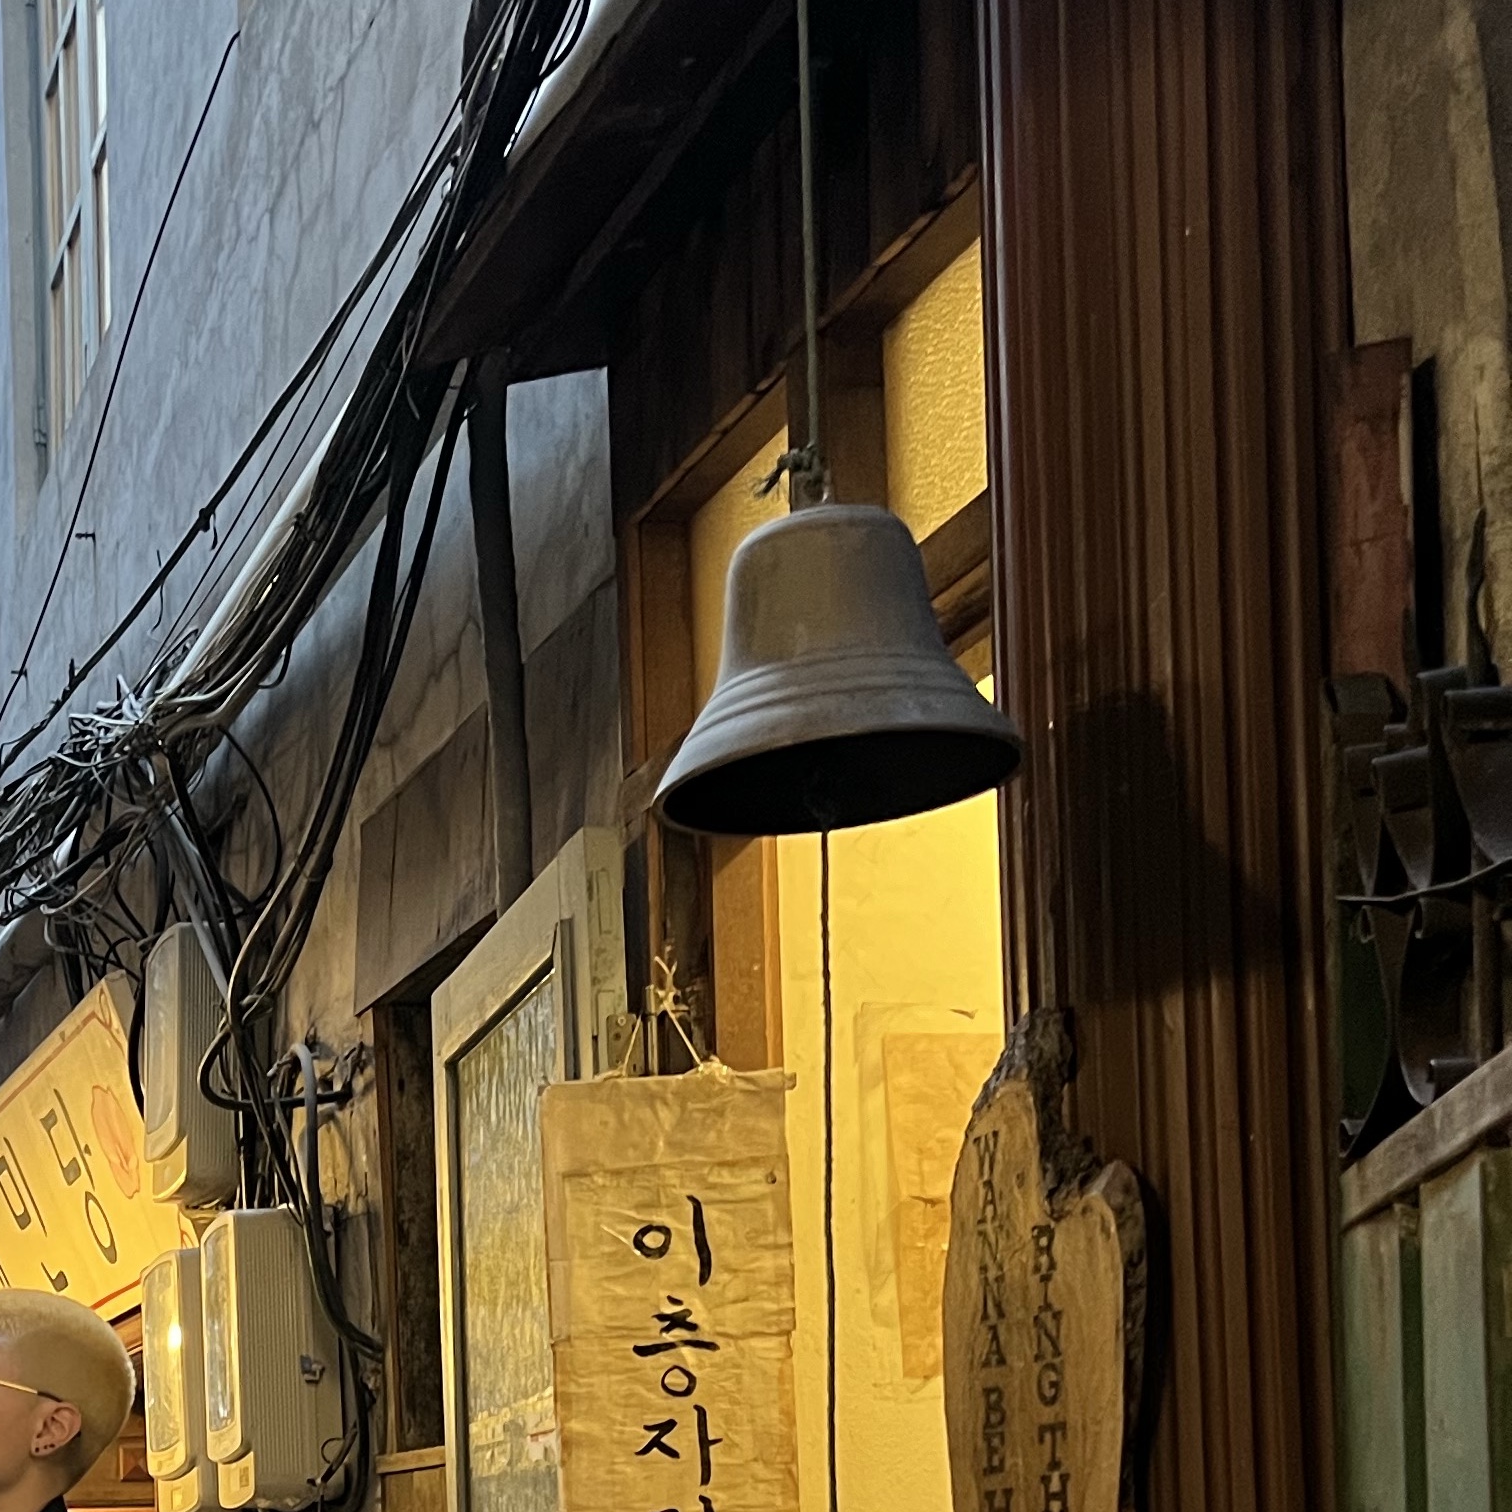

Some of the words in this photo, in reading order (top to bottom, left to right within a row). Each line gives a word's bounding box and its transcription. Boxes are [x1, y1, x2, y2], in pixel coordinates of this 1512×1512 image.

[972, 1129, 1007, 1369] WANNA
[1031, 1224, 1064, 1407] RING
[981, 1386, 1006, 1477] BE
